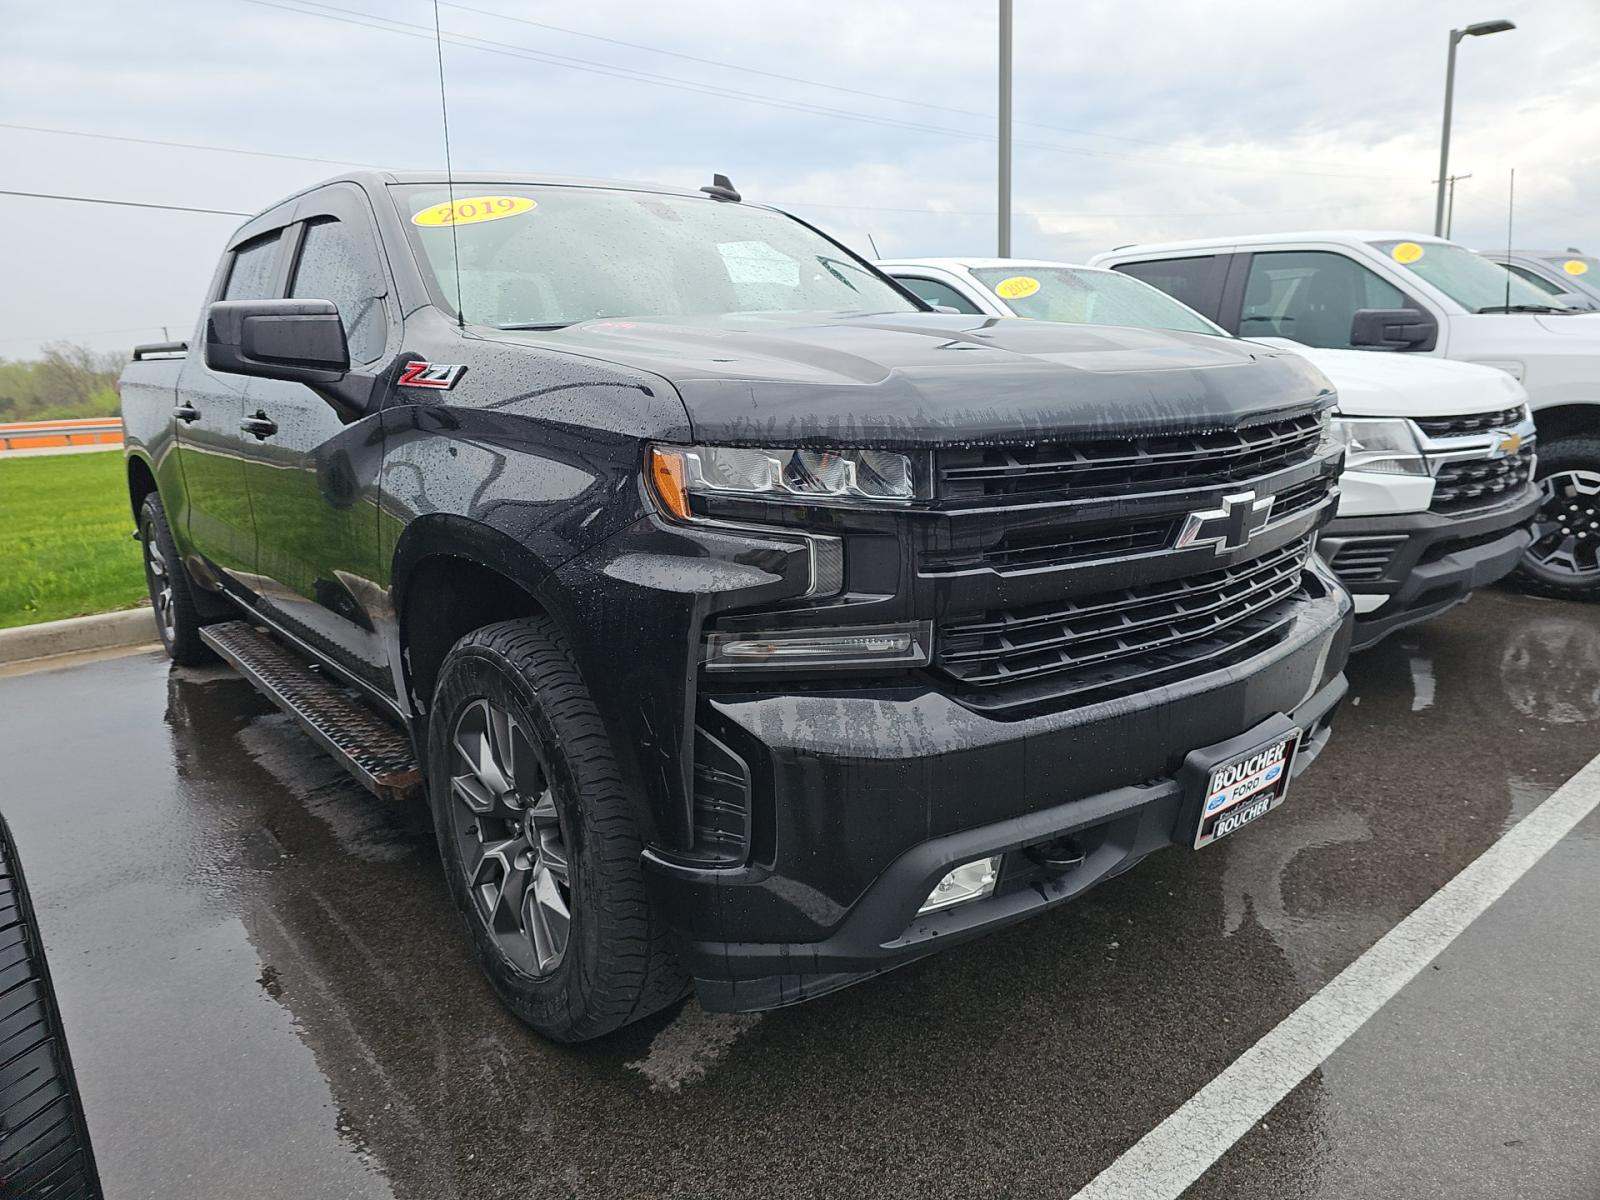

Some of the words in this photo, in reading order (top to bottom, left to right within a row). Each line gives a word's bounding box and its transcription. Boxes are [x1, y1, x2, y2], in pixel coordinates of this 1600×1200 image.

[438, 198, 515, 223] 2019
[398, 360, 464, 389] Z71
[1213, 742, 1286, 792] BOUCHER
[1232, 777, 1260, 800] FORD
[1217, 798, 1269, 837] BOUCHER
